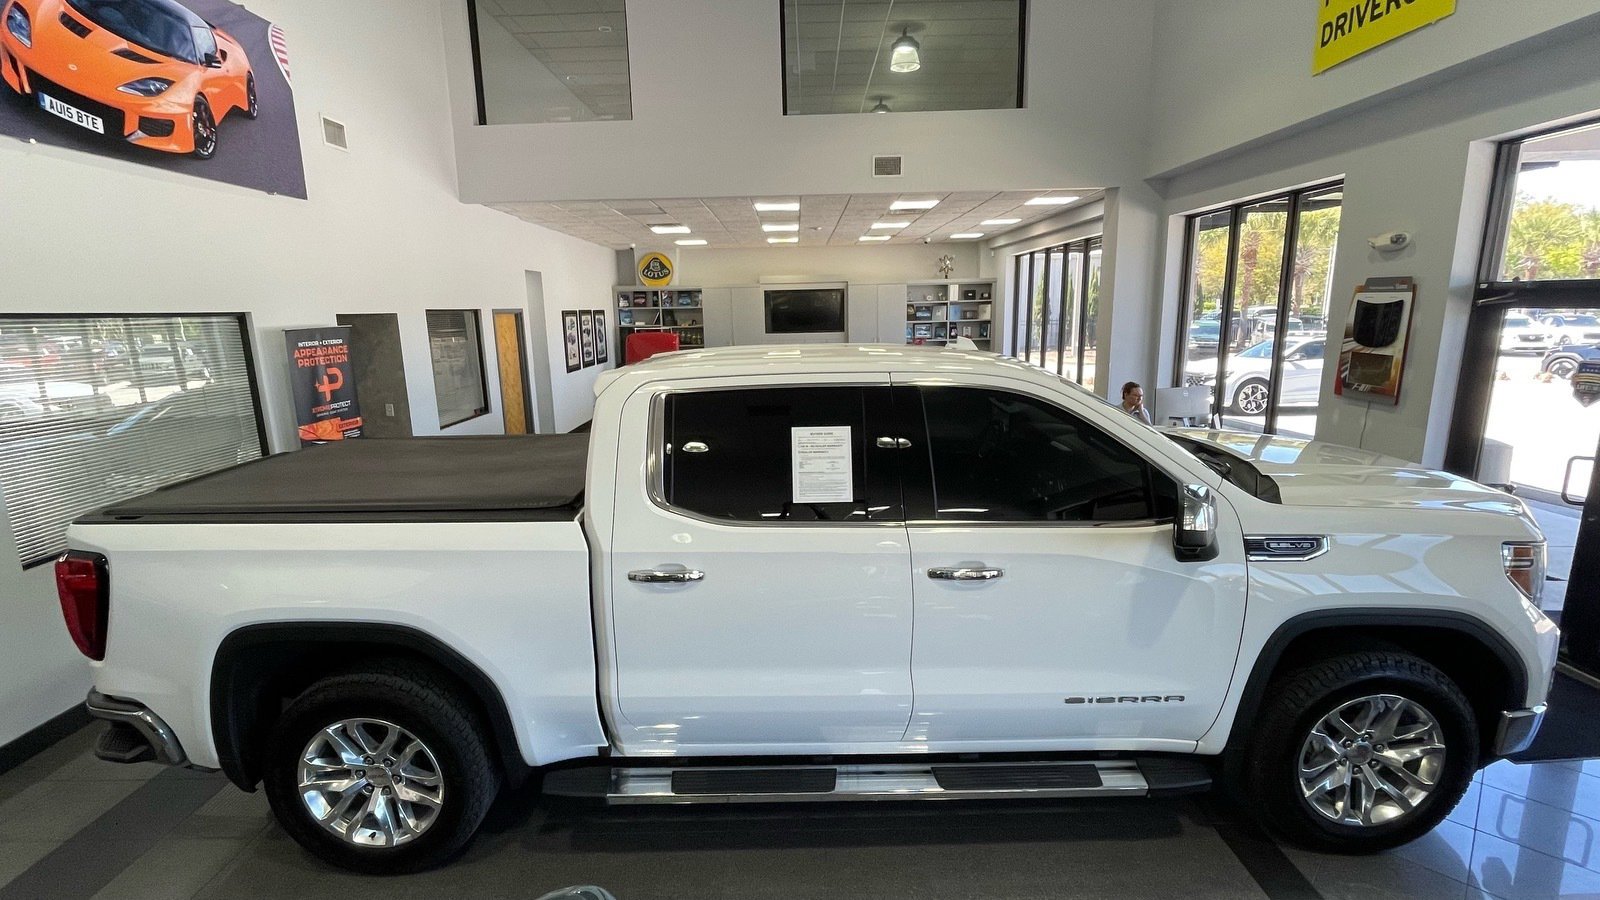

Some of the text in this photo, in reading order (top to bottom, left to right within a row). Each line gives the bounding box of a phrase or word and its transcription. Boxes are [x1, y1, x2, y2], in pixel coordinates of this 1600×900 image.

[1320, 0, 1415, 48] DRIVER
[49, 98, 99, 130] AU15 BTE
[643, 268, 669, 278] LOTUS
[294, 345, 348, 359] APPEARANCE
[298, 354, 347, 368] PROTECTION
[1064, 695, 1185, 704] SIERRA
